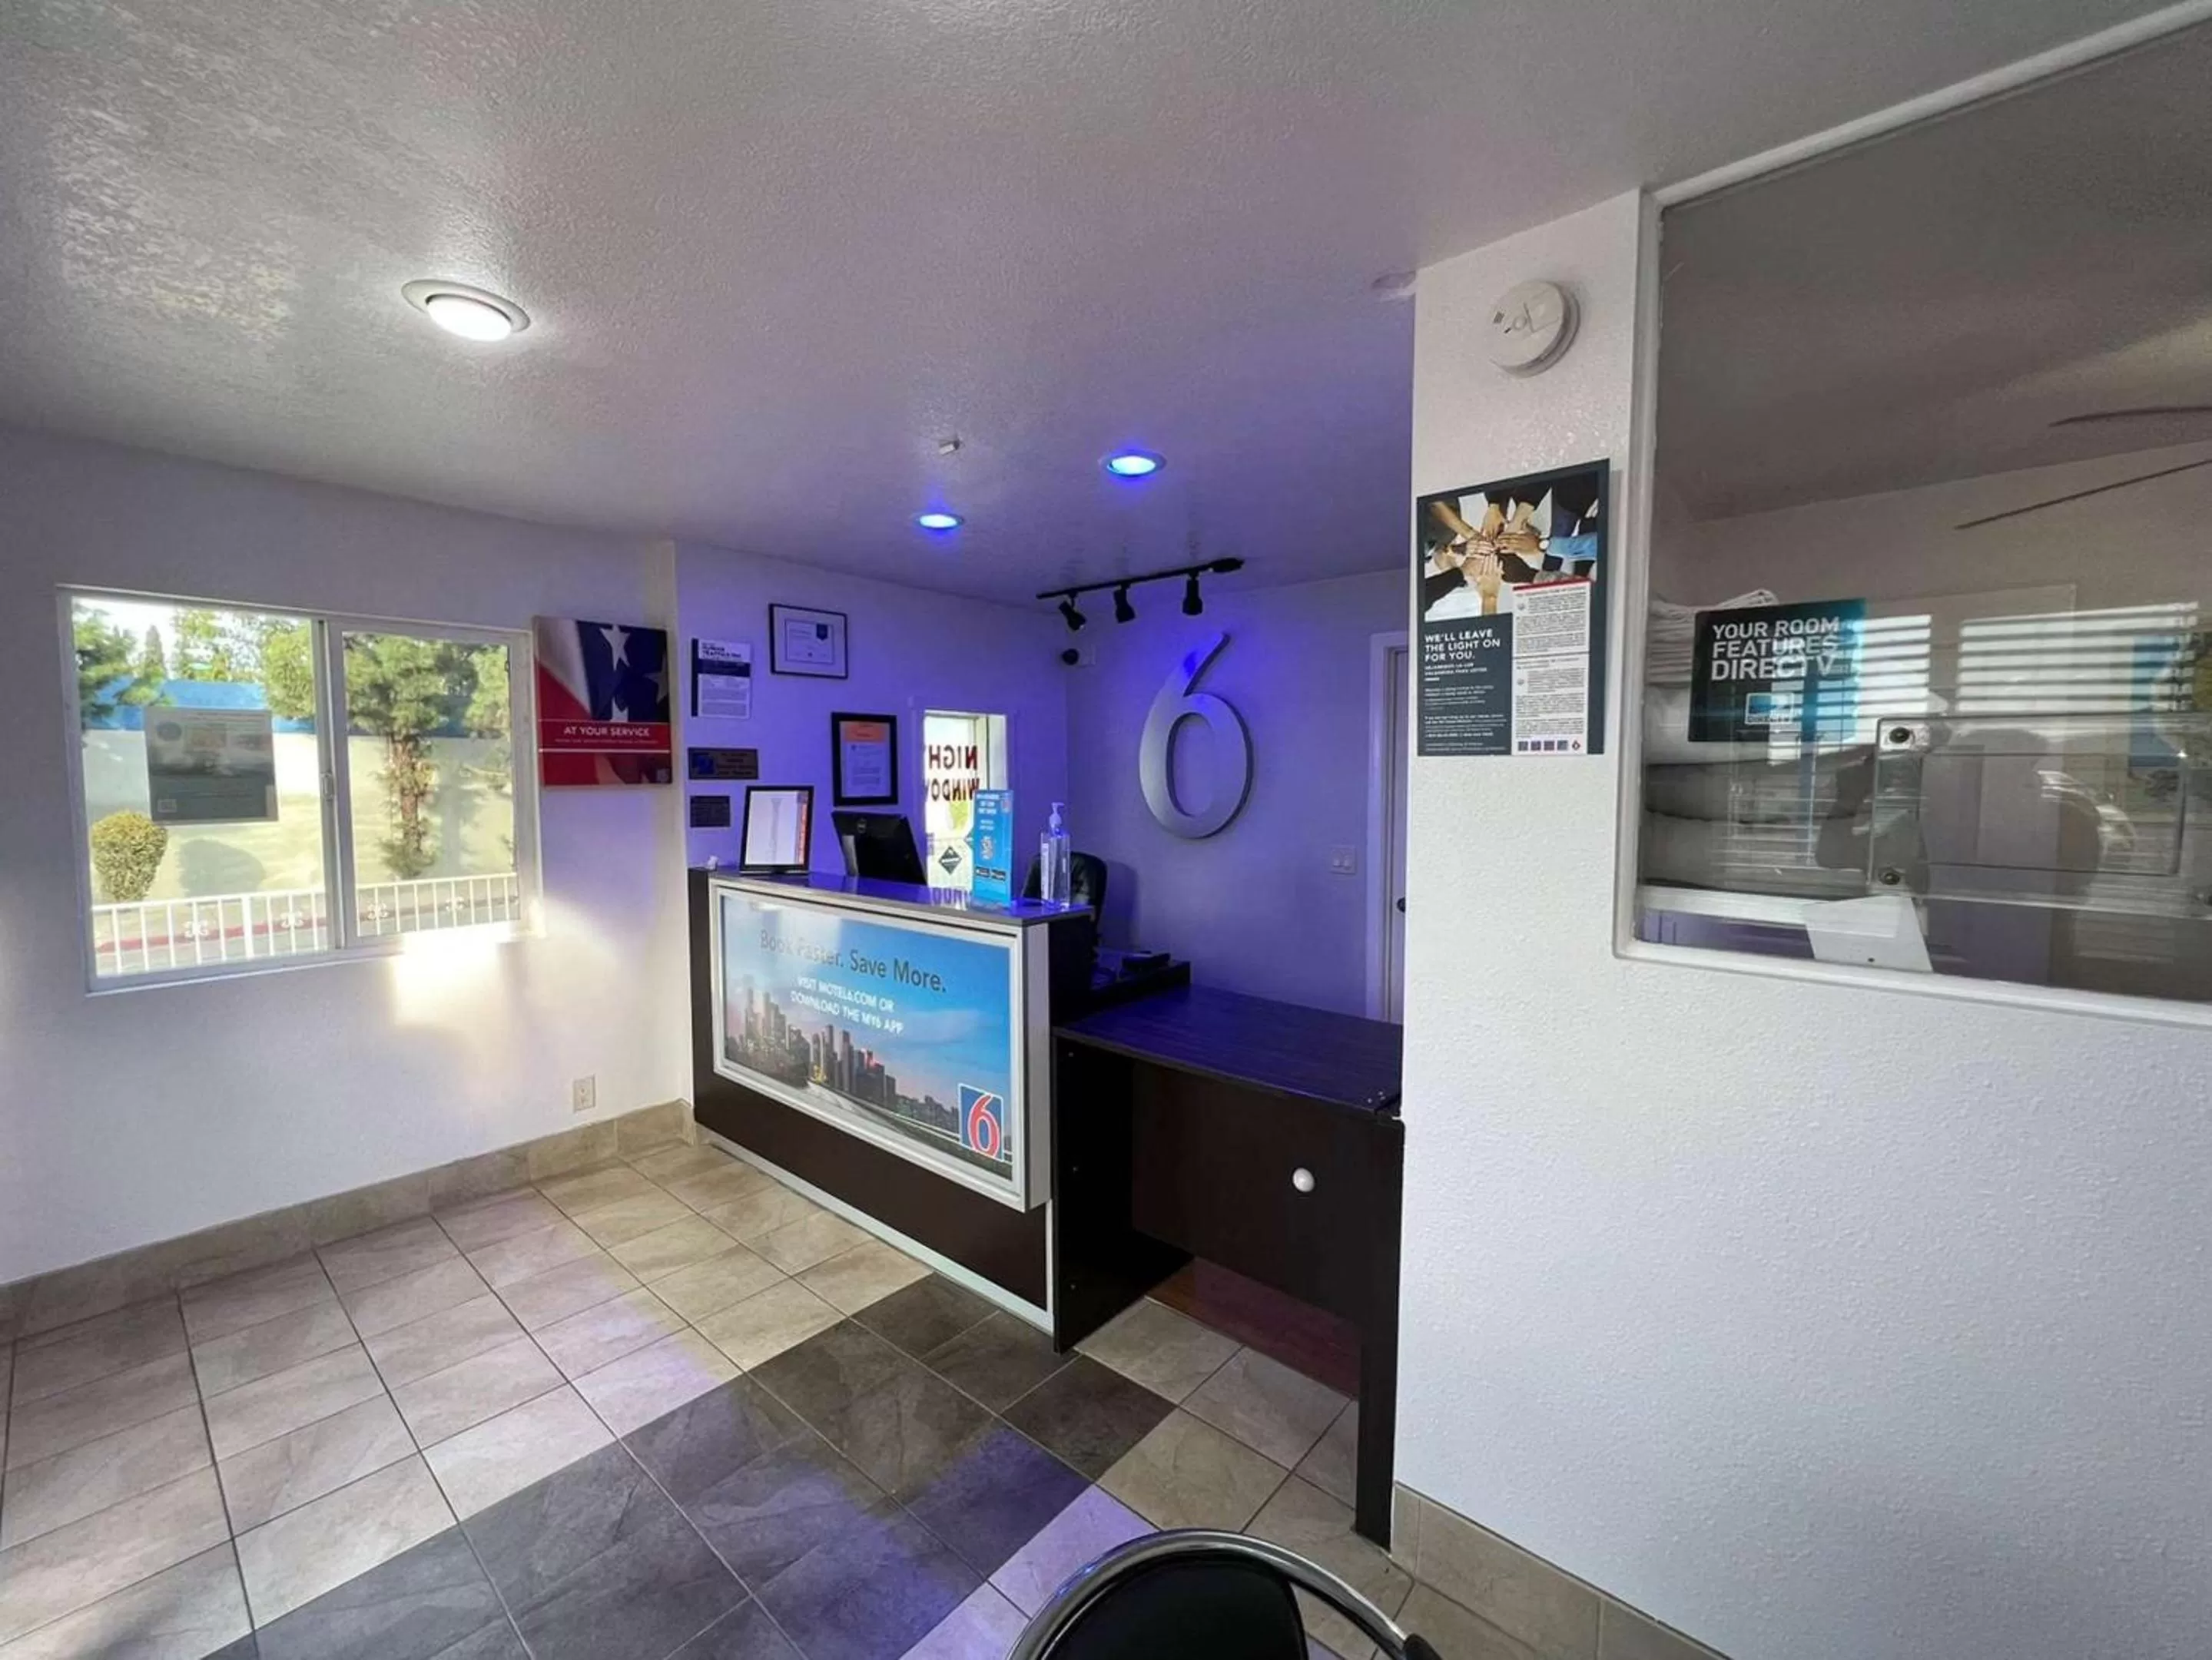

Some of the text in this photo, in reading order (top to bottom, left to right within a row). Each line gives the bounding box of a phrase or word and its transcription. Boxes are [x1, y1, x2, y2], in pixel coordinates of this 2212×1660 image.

[1424, 628, 1493, 643] WE'LL LEAVE
[1712, 616, 1840, 640] YOUR ROOM
[1425, 638, 1501, 652] THE LIGHT ON
[1425, 650, 1475, 661] FOR YOU.
[1712, 635, 1839, 658] FEATURES
[1711, 654, 1835, 681] DIRECTV
[564, 726, 649, 737] AT YOUR SERVICE
[1139, 631, 1254, 839] 6
[760, 929, 794, 956] Book
[850, 949, 887, 979] Save
[894, 958, 947, 993] More.
[797, 976, 817, 991] VISIT
[878, 998, 895, 1013] OR
[790, 989, 841, 1016] DOWNLOAD
[842, 1006, 861, 1023] THE
[883, 1019, 904, 1035] APP
[967, 1092, 1001, 1159] 6
